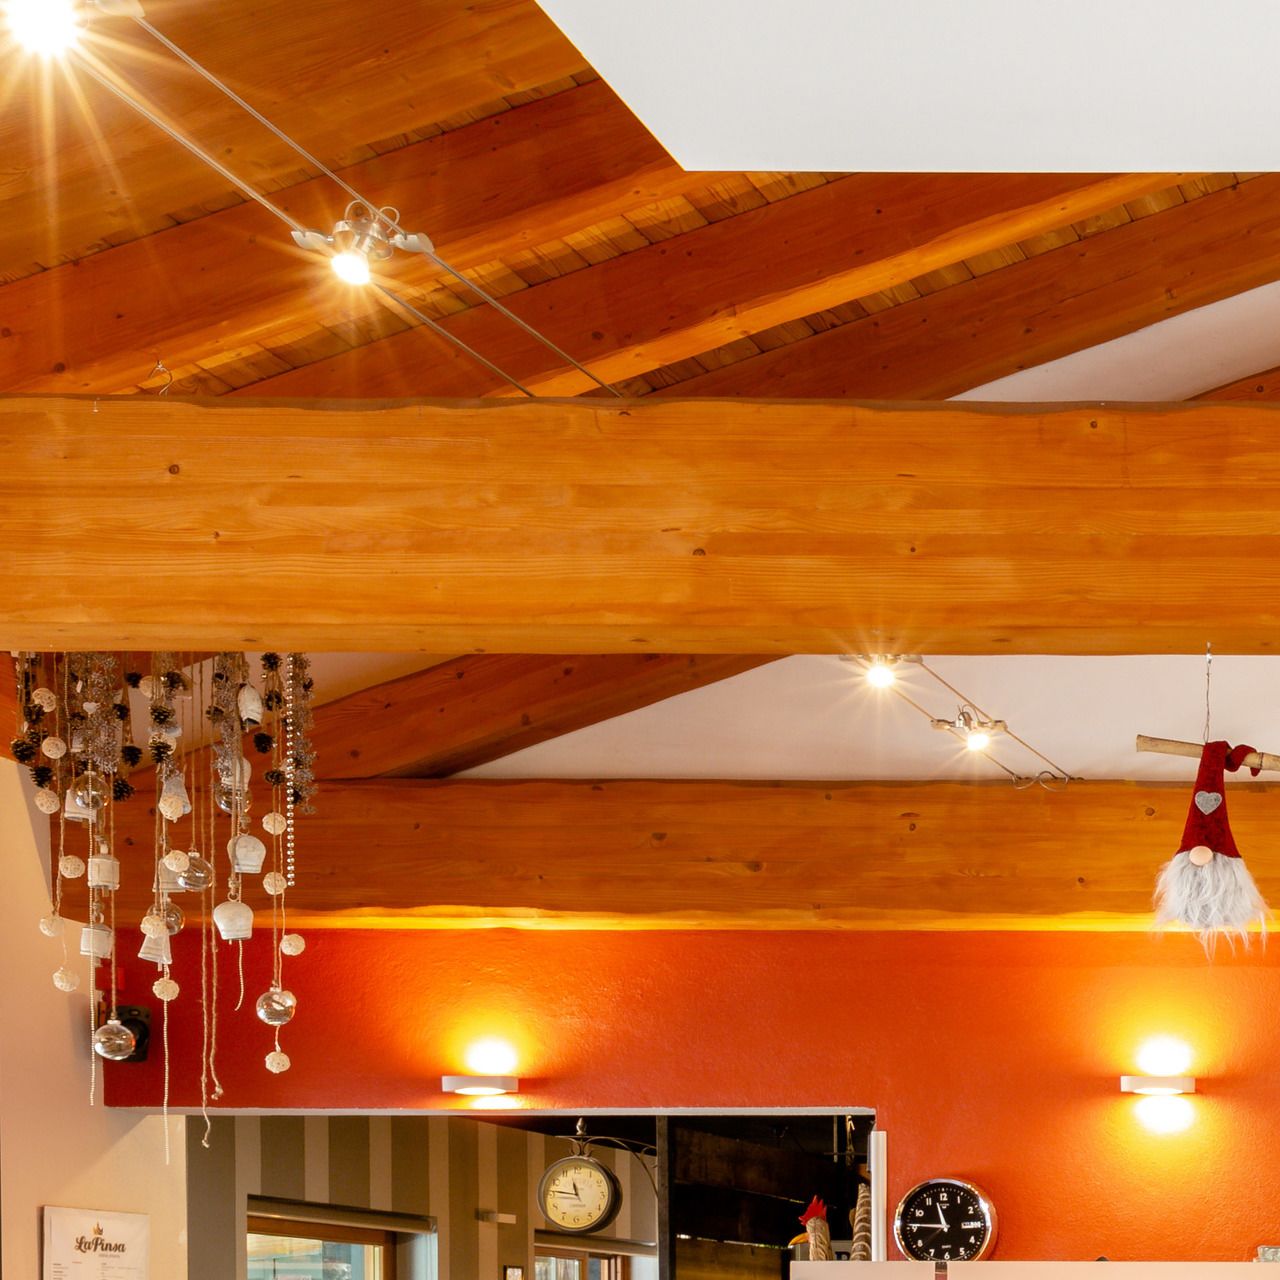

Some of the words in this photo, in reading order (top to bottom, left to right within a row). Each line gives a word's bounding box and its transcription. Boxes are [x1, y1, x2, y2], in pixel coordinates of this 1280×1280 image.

[940, 1193, 947, 1201] 12
[957, 1196, 960, 1204] 1
[915, 1209, 924, 1217] 10
